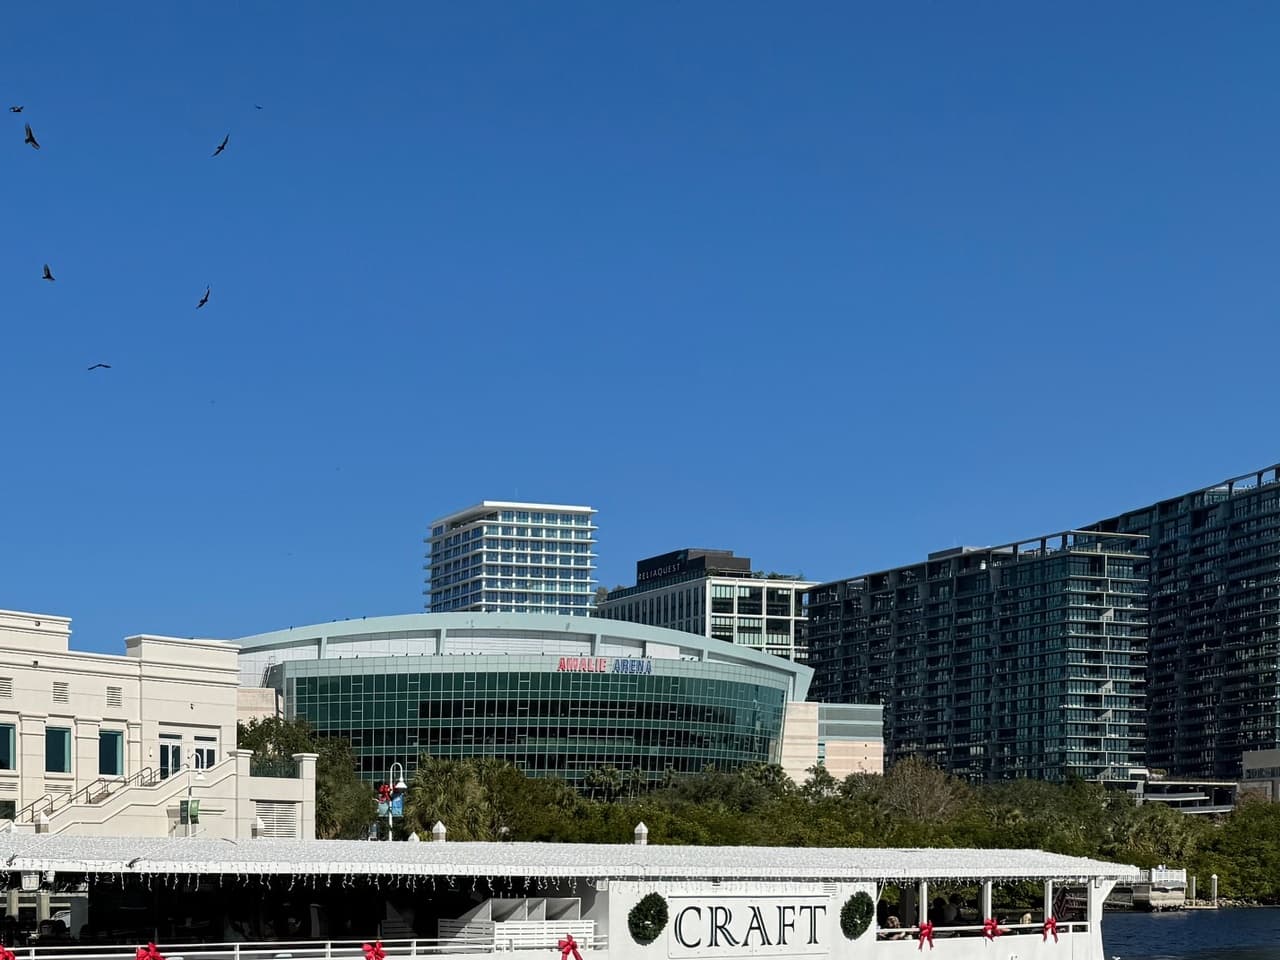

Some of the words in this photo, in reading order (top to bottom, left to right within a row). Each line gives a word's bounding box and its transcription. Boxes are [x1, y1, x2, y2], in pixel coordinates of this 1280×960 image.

[638, 563, 681, 580] RELIAQUEST
[557, 657, 607, 673] AMALIE
[612, 658, 653, 674] ARENA
[674, 905, 827, 949] CRAFT
